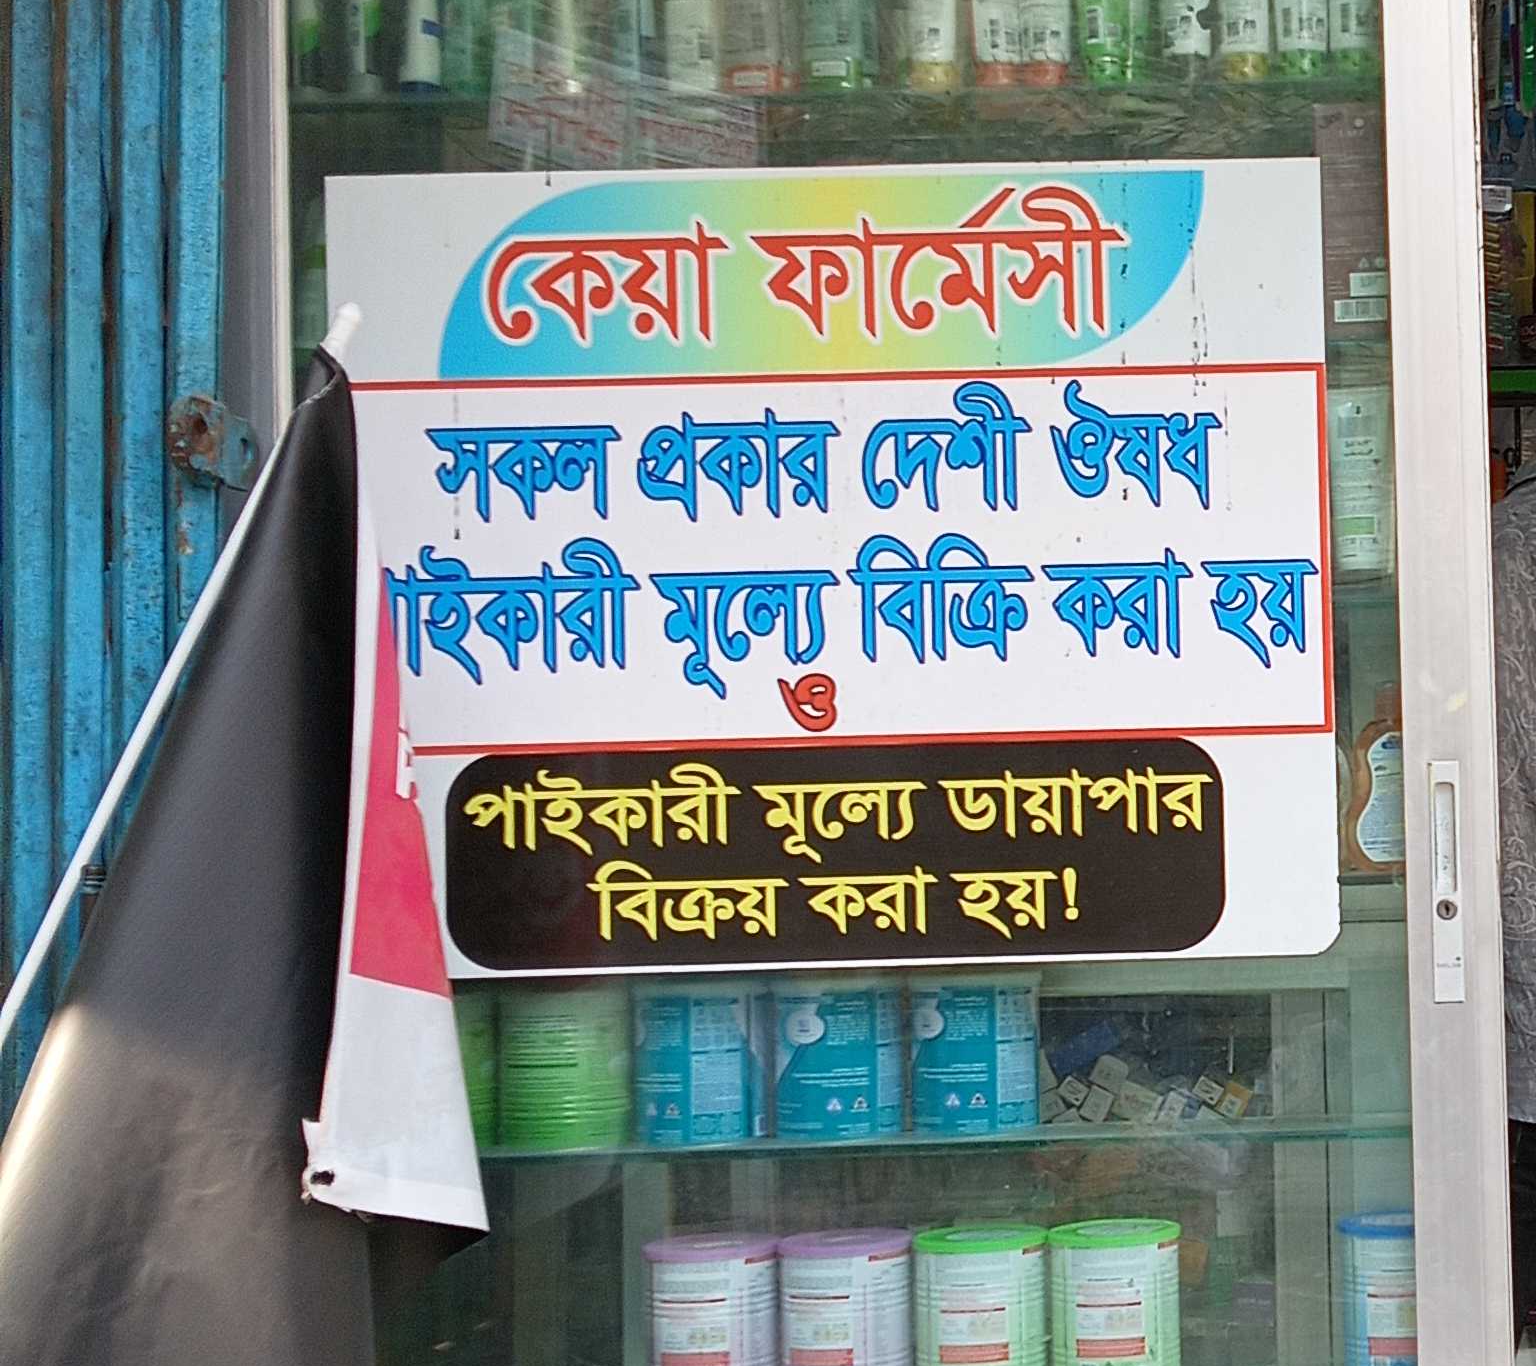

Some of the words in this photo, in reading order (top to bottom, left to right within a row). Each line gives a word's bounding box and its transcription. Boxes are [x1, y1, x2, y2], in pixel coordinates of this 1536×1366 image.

[488, 222, 727, 341] কেয়া
[752, 187, 1123, 335] ফার্মেসী
[427, 425, 619, 522] সকল
[637, 409, 838, 521] প্রকার
[862, 382, 1030, 511] দেশী
[1051, 380, 1221, 508] ঔষধ
[650, 570, 834, 699] মূল্যে
[849, 533, 1033, 663] বিক্রি
[1042, 548, 1191, 658] করা
[1201, 559, 1317, 668] হয়
[779, 674, 836, 732] ও
[464, 765, 739, 855] পাইকারী
[755, 782, 925, 863] মূল্যে
[940, 767, 1213, 836] ডায়াপার
[591, 861, 788, 940] বিক্রয়
[801, 866, 936, 934] করা
[952, 868, 1078, 939] হয়!
